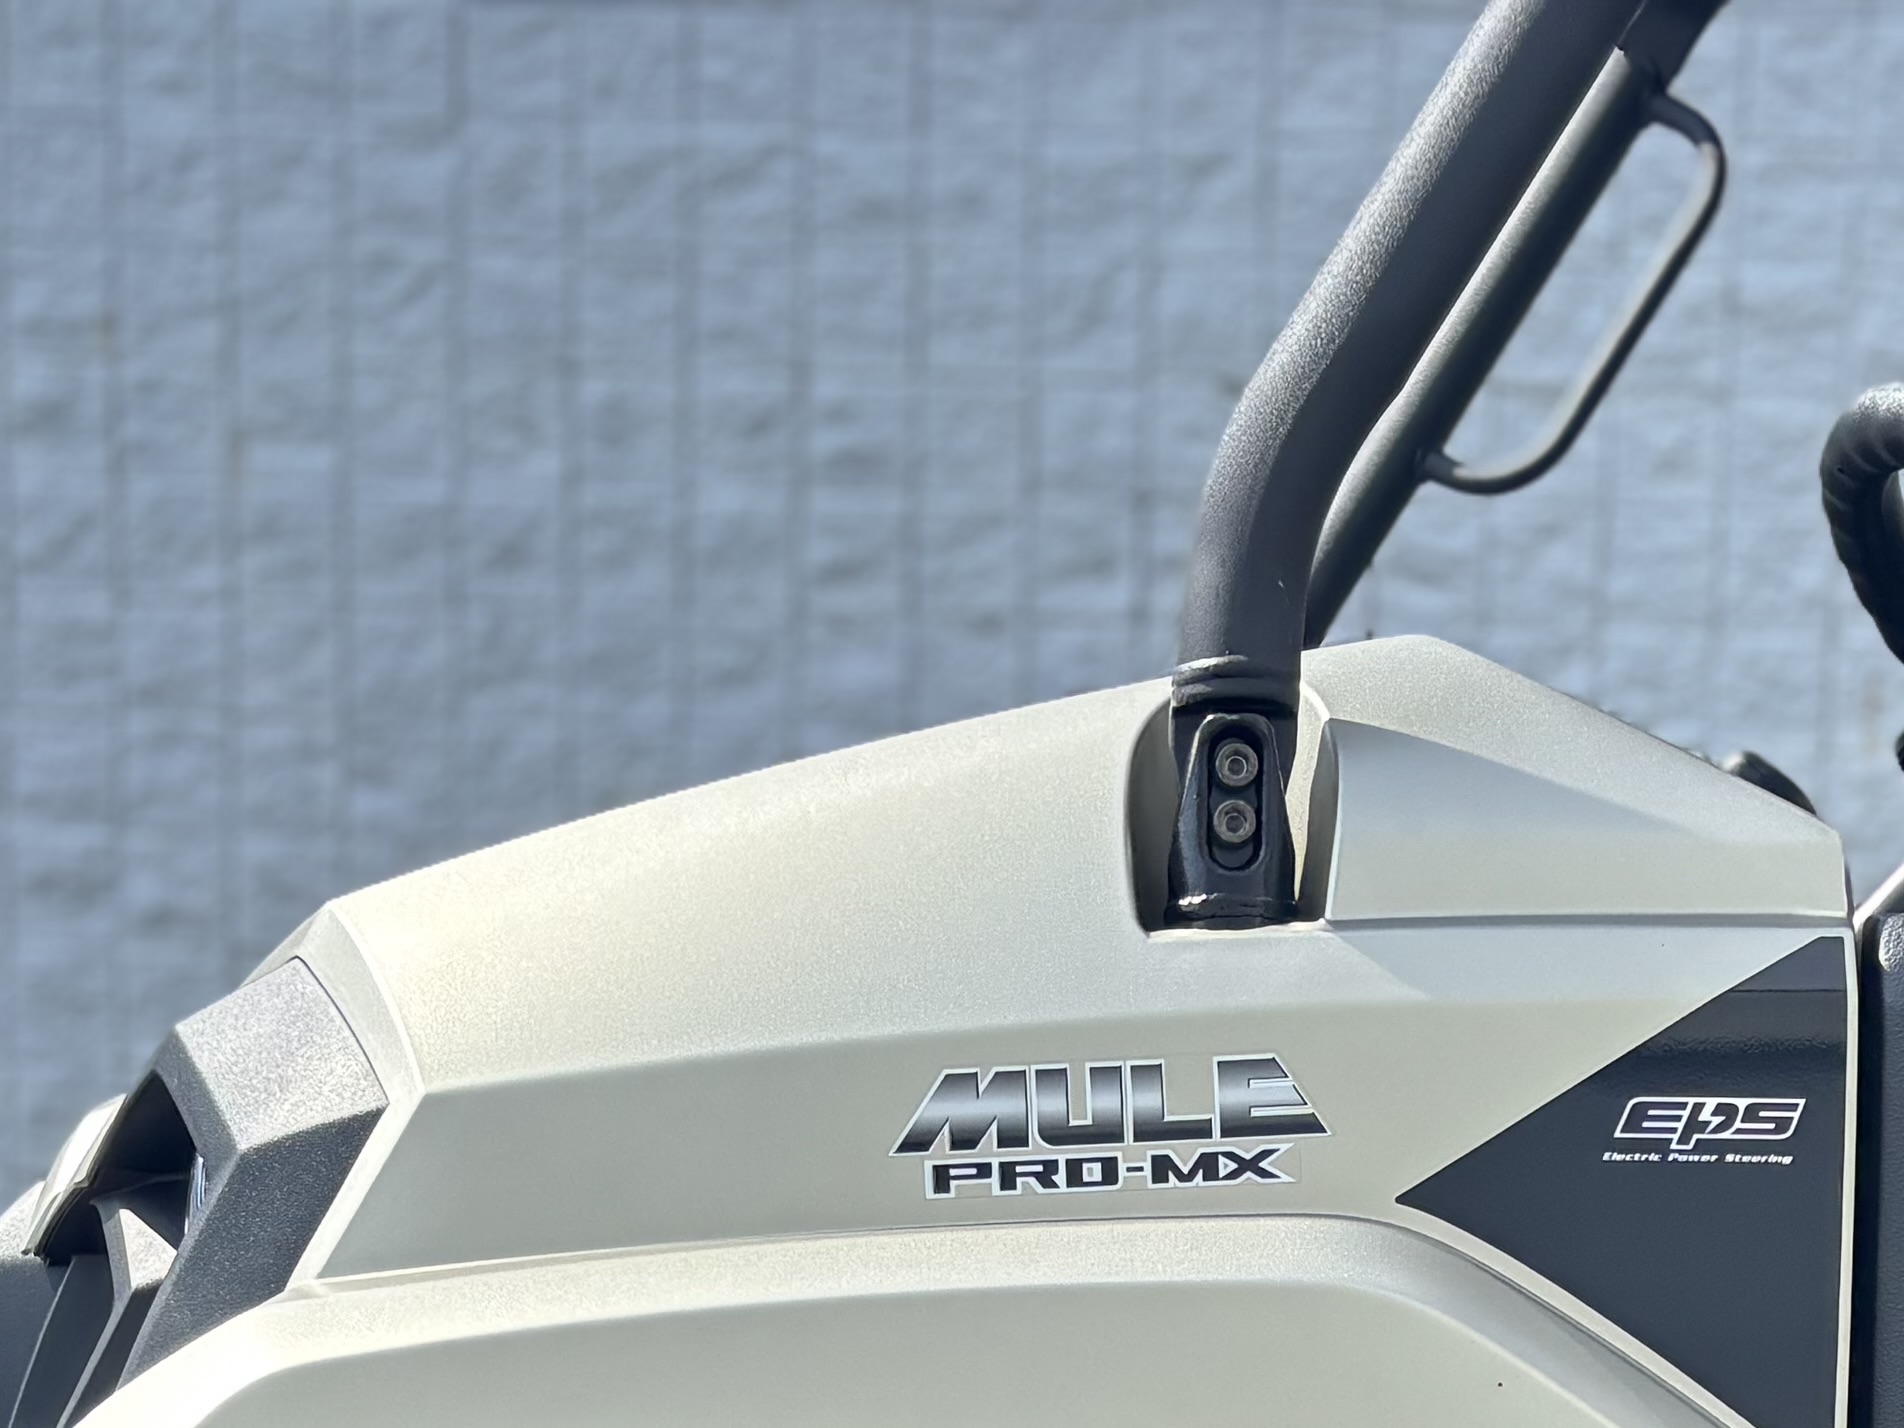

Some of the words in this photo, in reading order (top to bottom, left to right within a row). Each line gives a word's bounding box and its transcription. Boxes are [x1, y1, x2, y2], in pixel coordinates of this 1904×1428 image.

[889, 1053, 1332, 1156] MULE
[1613, 1096, 1806, 1150] EPS
[924, 1142, 1296, 1200] PRO-MX
[1602, 1151, 1663, 1163] Electric
[1668, 1152, 1719, 1163] Power
[1724, 1153, 1794, 1165] Steering
